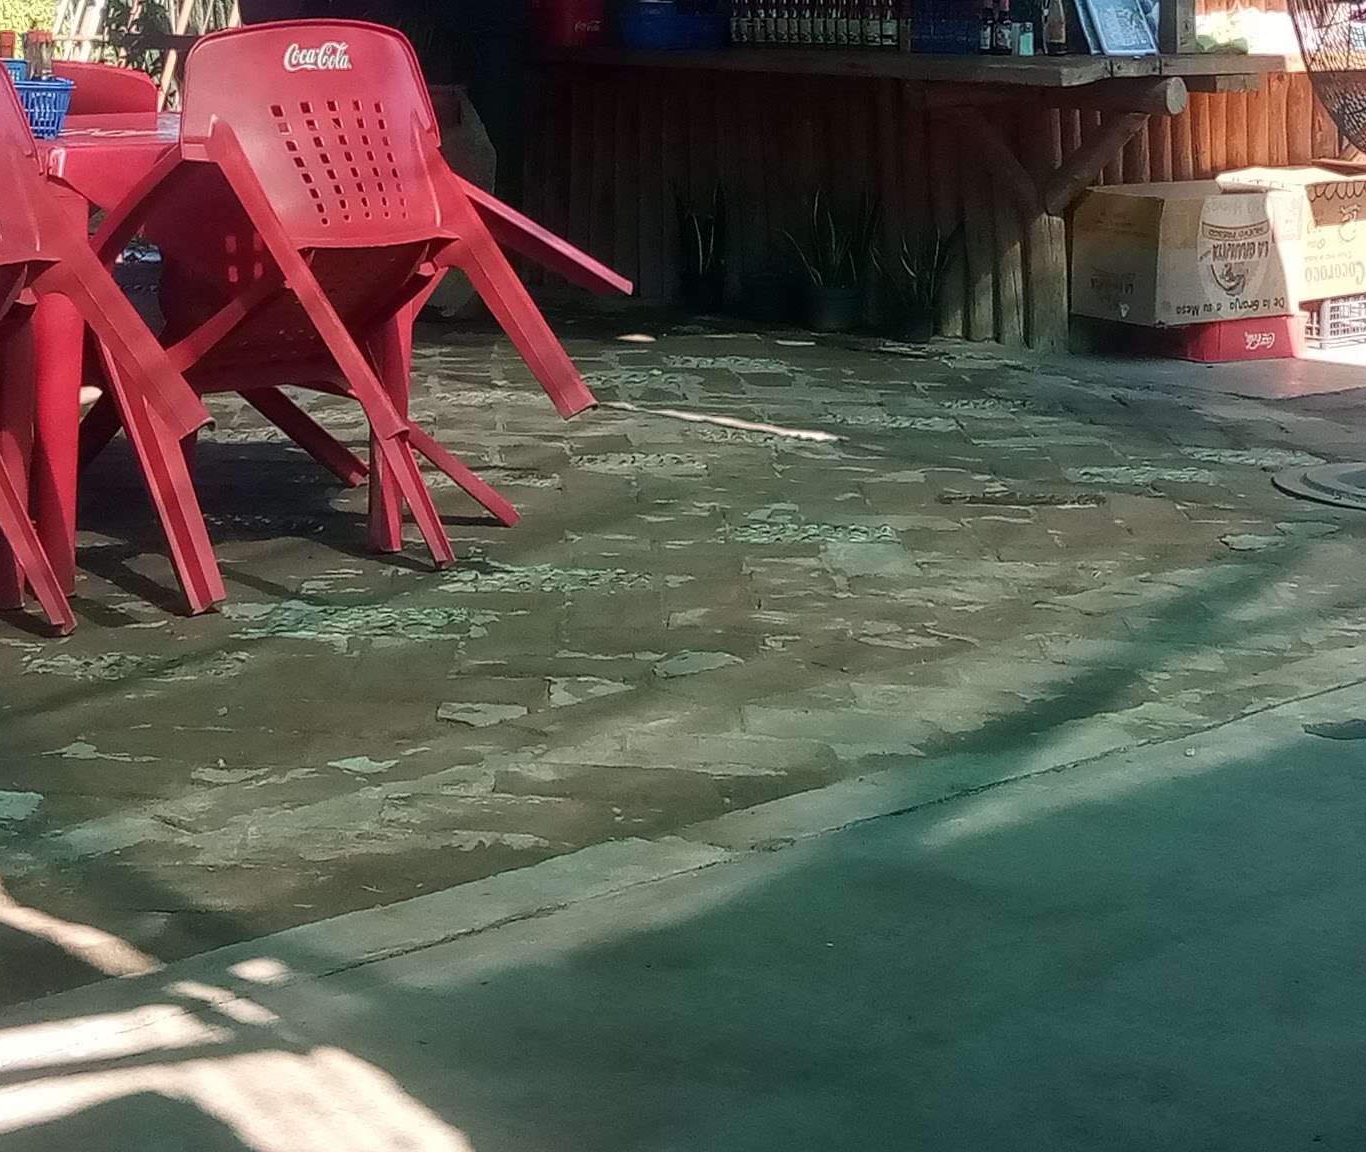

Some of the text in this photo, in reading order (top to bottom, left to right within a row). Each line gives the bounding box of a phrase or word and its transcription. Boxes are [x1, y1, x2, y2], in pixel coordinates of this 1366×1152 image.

[283, 42, 352, 71] Coca-Cola
[1258, 240, 1269, 258] LA
[1203, 303, 1214, 313] su
[1230, 298, 1259, 313] Granja
[1263, 299, 1270, 309] la
[1273, 297, 1285, 308] De
[1176, 304, 1200, 316] Mesa
